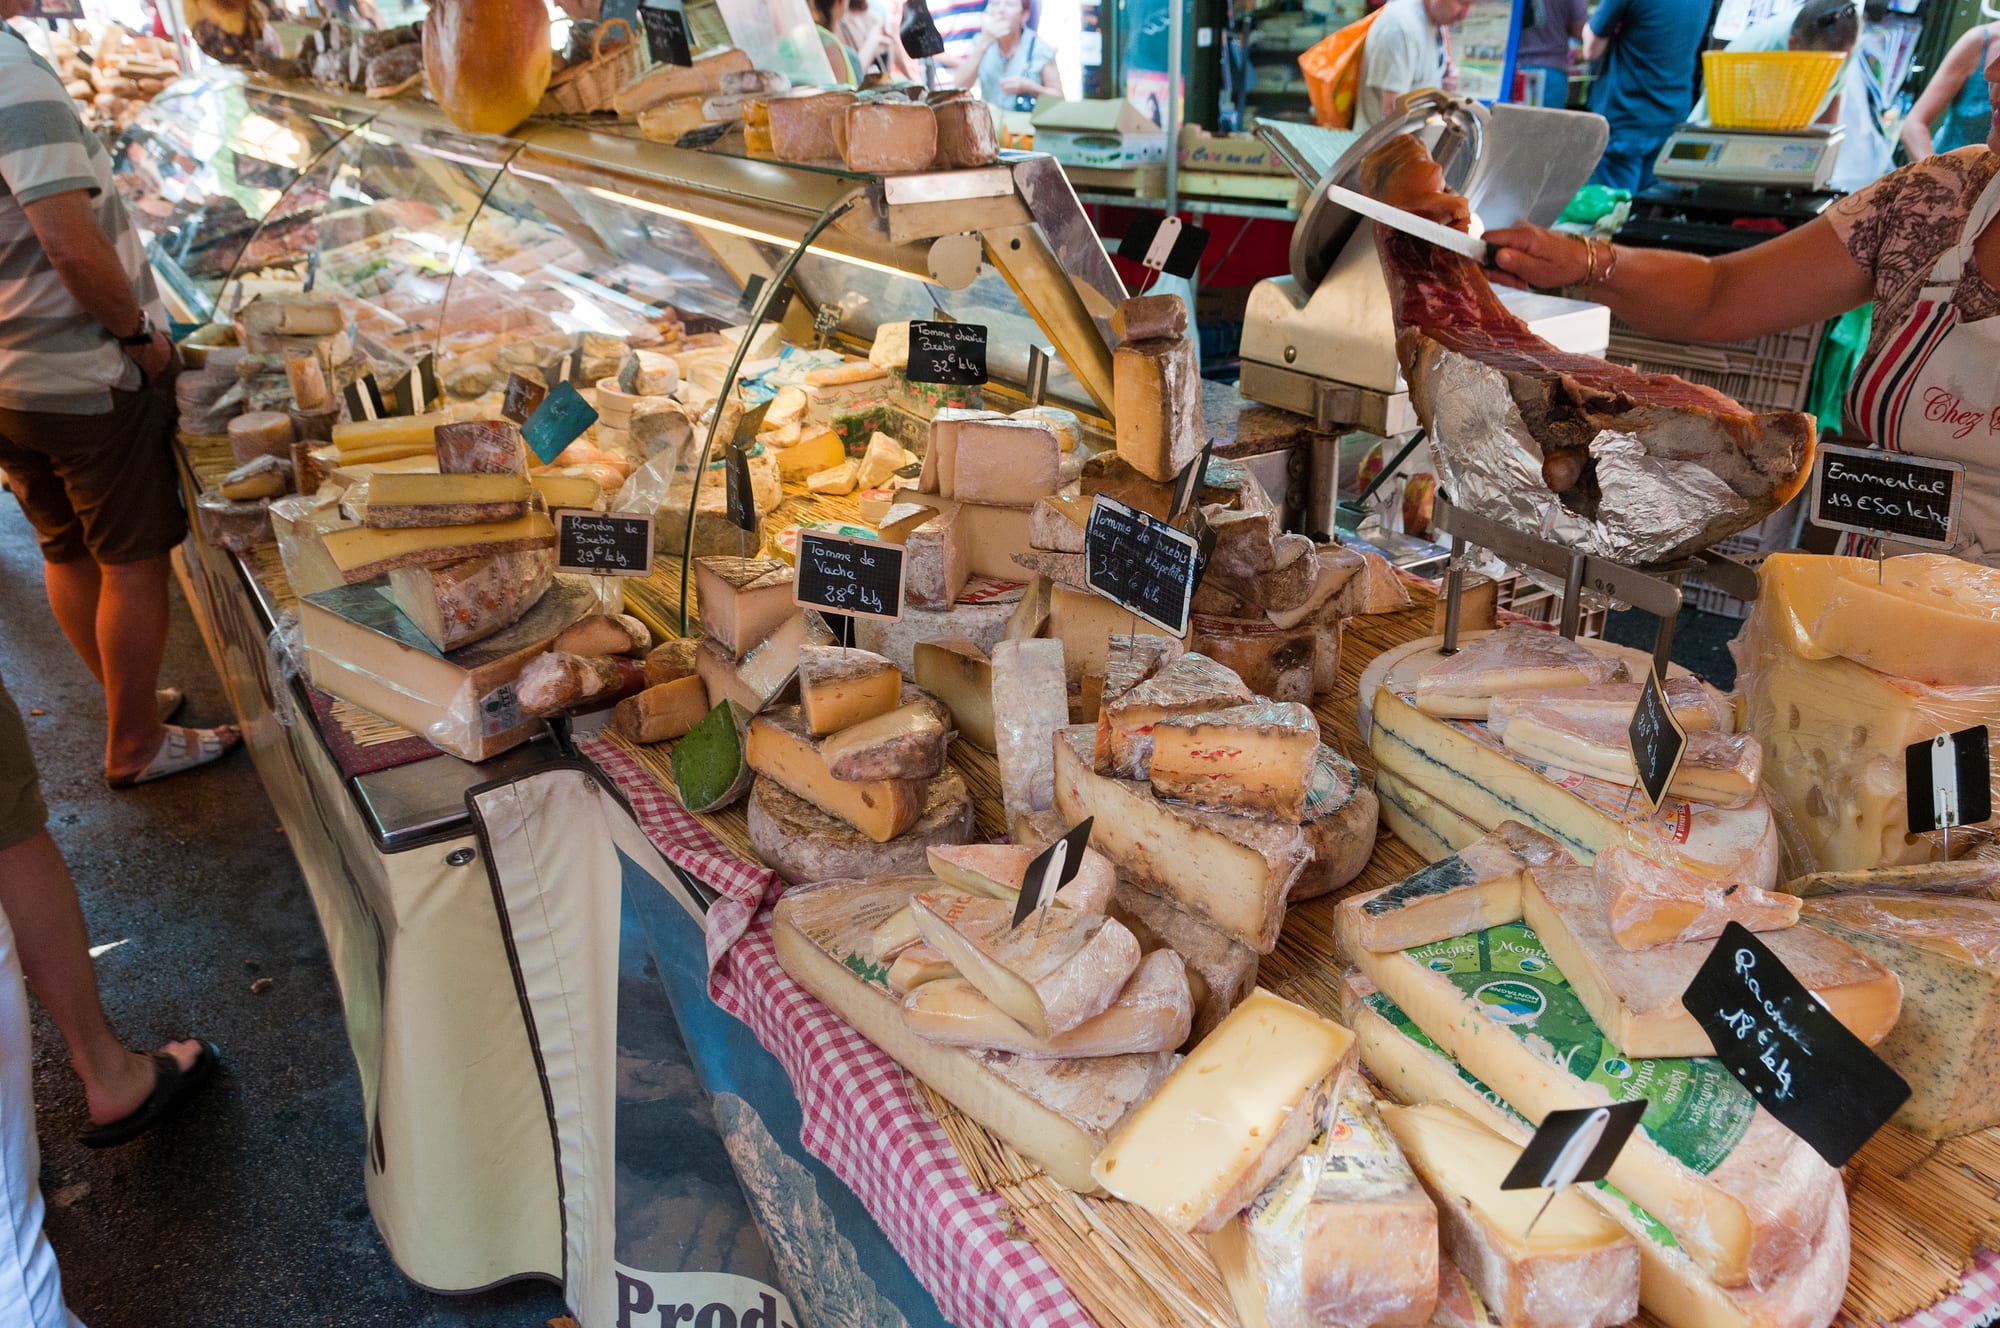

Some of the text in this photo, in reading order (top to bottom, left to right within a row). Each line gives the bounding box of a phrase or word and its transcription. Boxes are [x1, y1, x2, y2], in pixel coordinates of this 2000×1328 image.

[911, 322, 950, 338] Tomme
[1923, 386, 1984, 439] Chez
[1828, 462, 1945, 495] Emmental
[1095, 505, 1132, 535] Tomme
[1137, 526, 1150, 544] de
[802, 539, 875, 567] Tomme de
[814, 558, 856, 580] Vache
[1407, 944, 1475, 961] ontagne
[1689, 1071, 1719, 1126] Fromager
